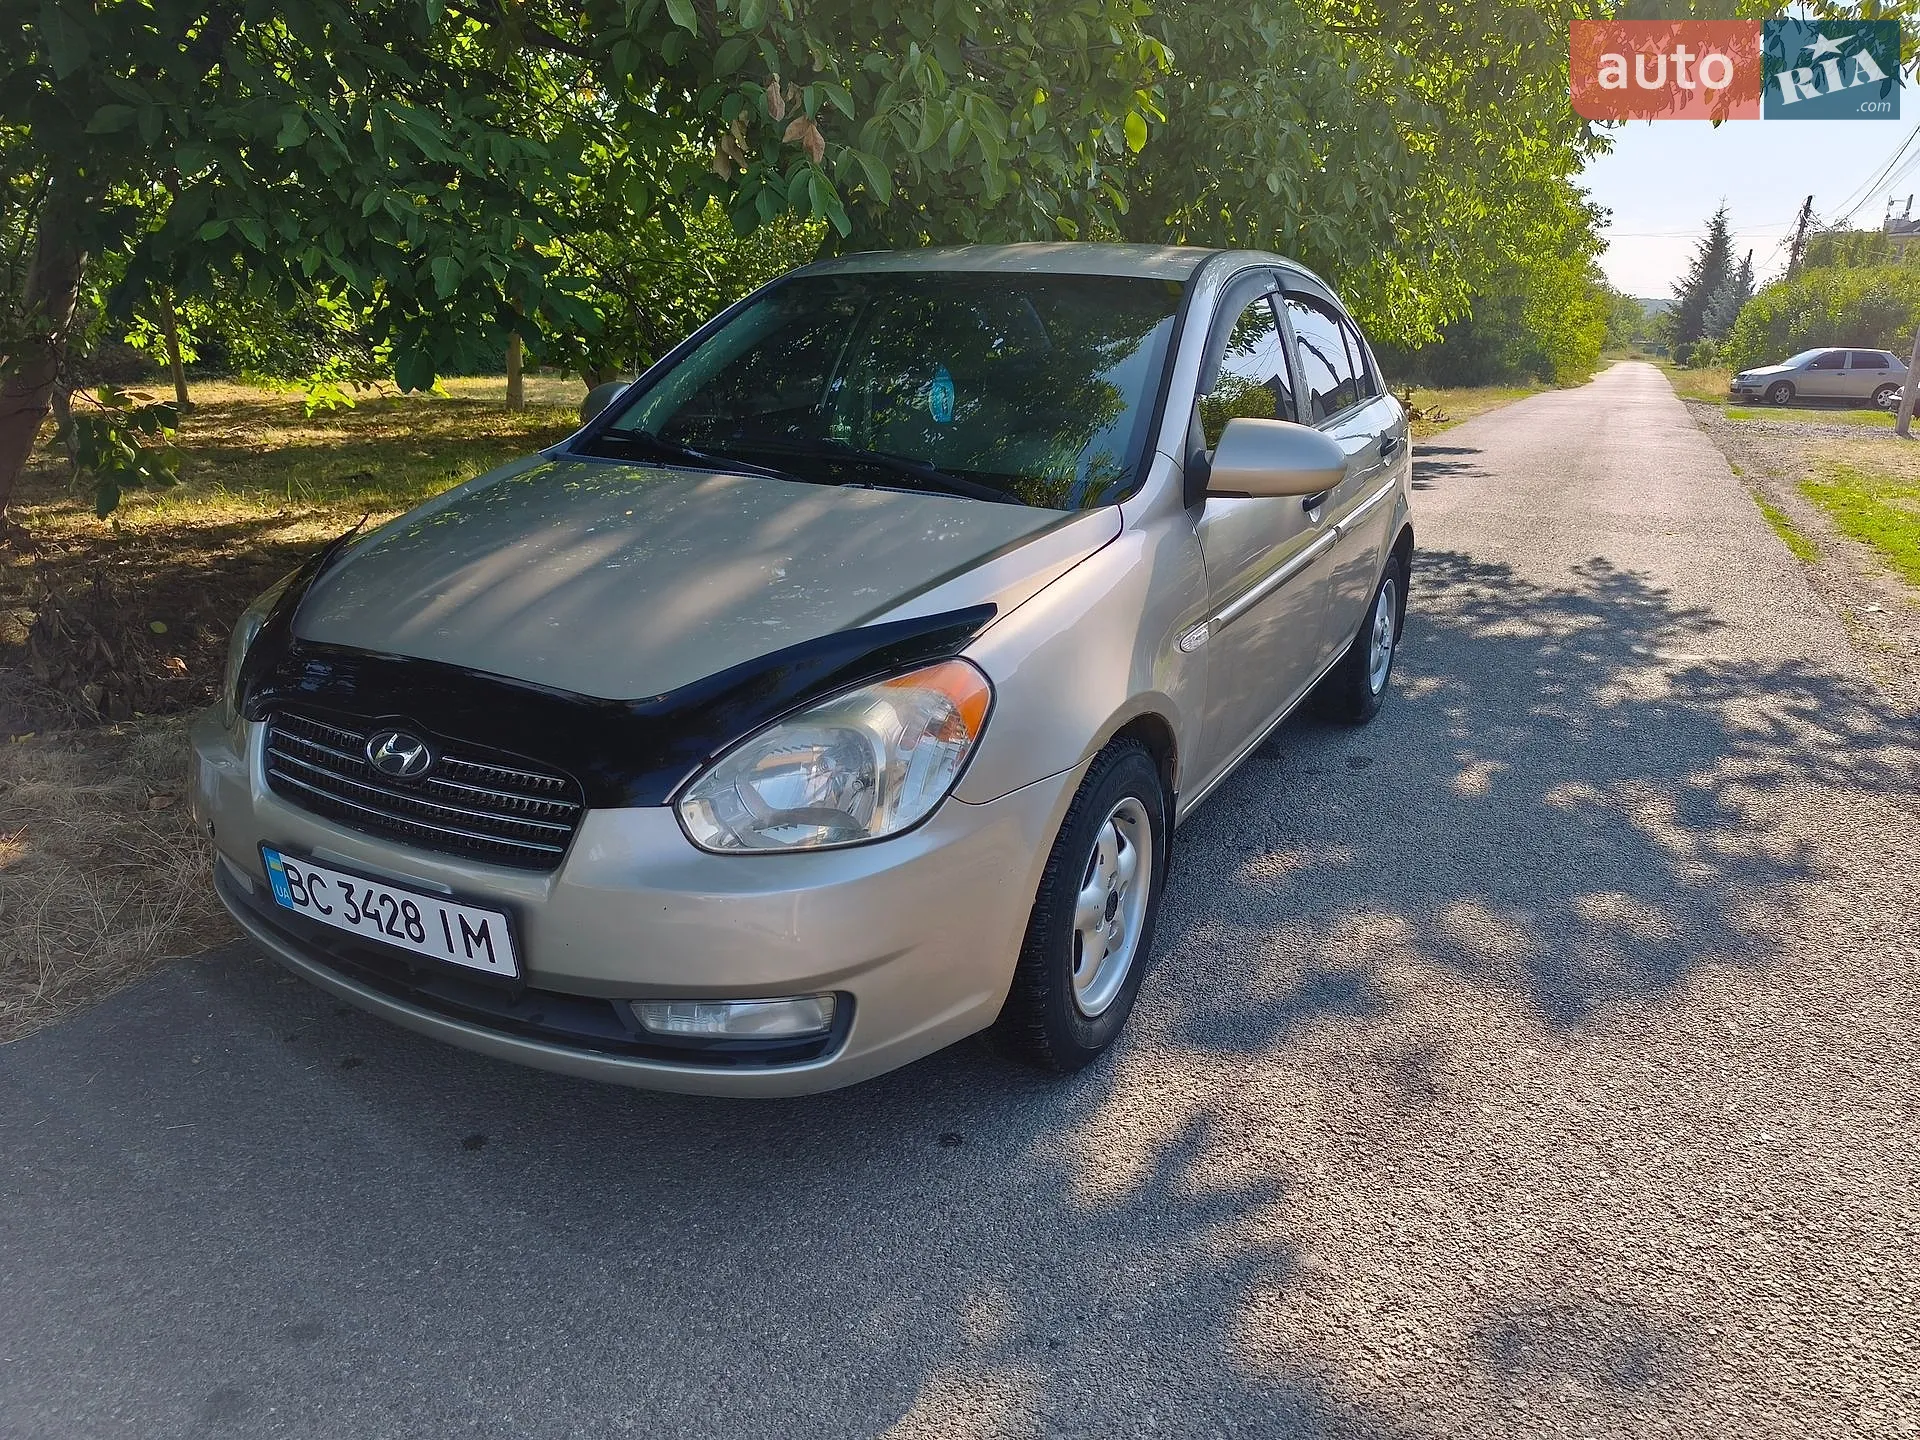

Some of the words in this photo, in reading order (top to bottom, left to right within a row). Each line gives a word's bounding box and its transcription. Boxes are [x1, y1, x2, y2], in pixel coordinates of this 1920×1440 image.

[275, 885, 291, 900] UA
[282, 861, 333, 915] BC
[337, 880, 426, 944] 3428
[439, 908, 496, 963] IM
